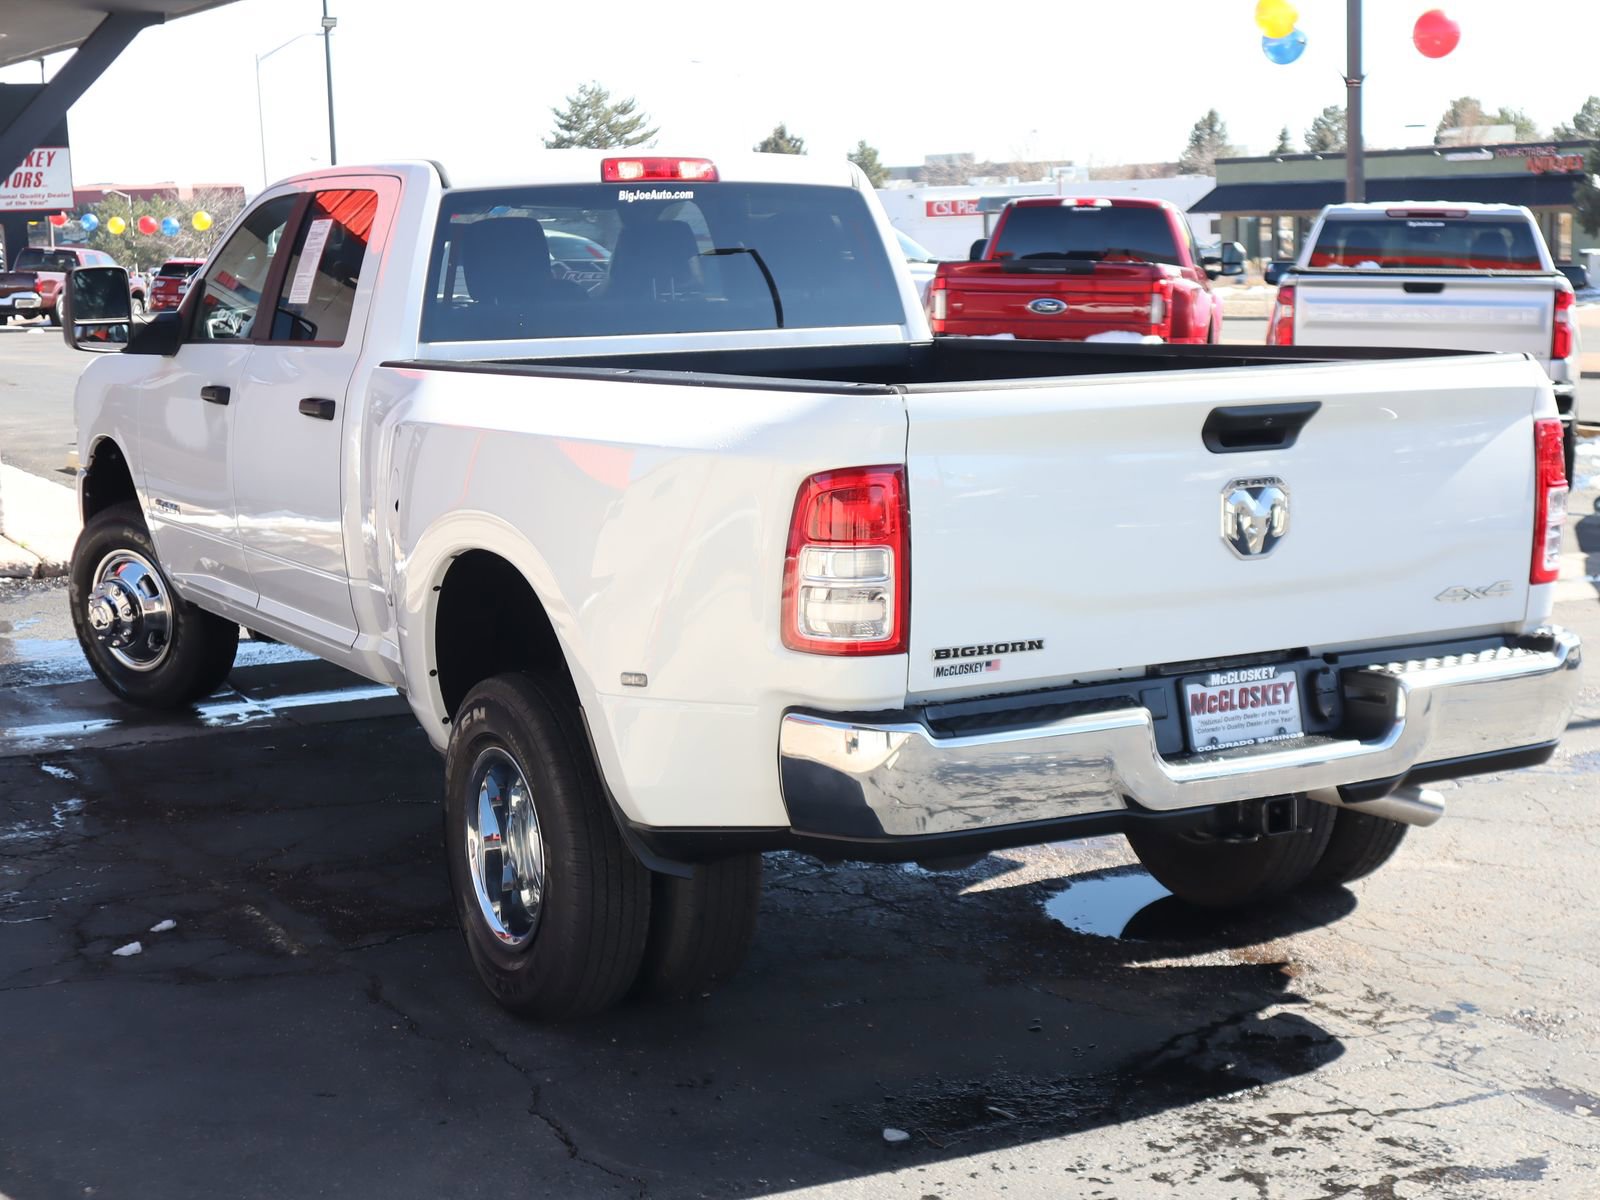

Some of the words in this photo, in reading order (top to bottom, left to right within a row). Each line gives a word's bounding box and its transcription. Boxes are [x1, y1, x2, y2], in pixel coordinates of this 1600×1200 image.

[618, 189, 694, 203] BigJoeAuto.com
[933, 639, 1045, 660] BIGHORN
[935, 661, 985, 678] McCLOSKEY
[1211, 666, 1276, 686] McCLOSKEY
[1191, 681, 1295, 715] McCLOSKEY
[1243, 713, 1260, 721] Dealer
[1246, 720, 1263, 728] Dealer
[1197, 739, 1255, 752] COLORADO
[1257, 731, 1304, 743] SPRINGS
